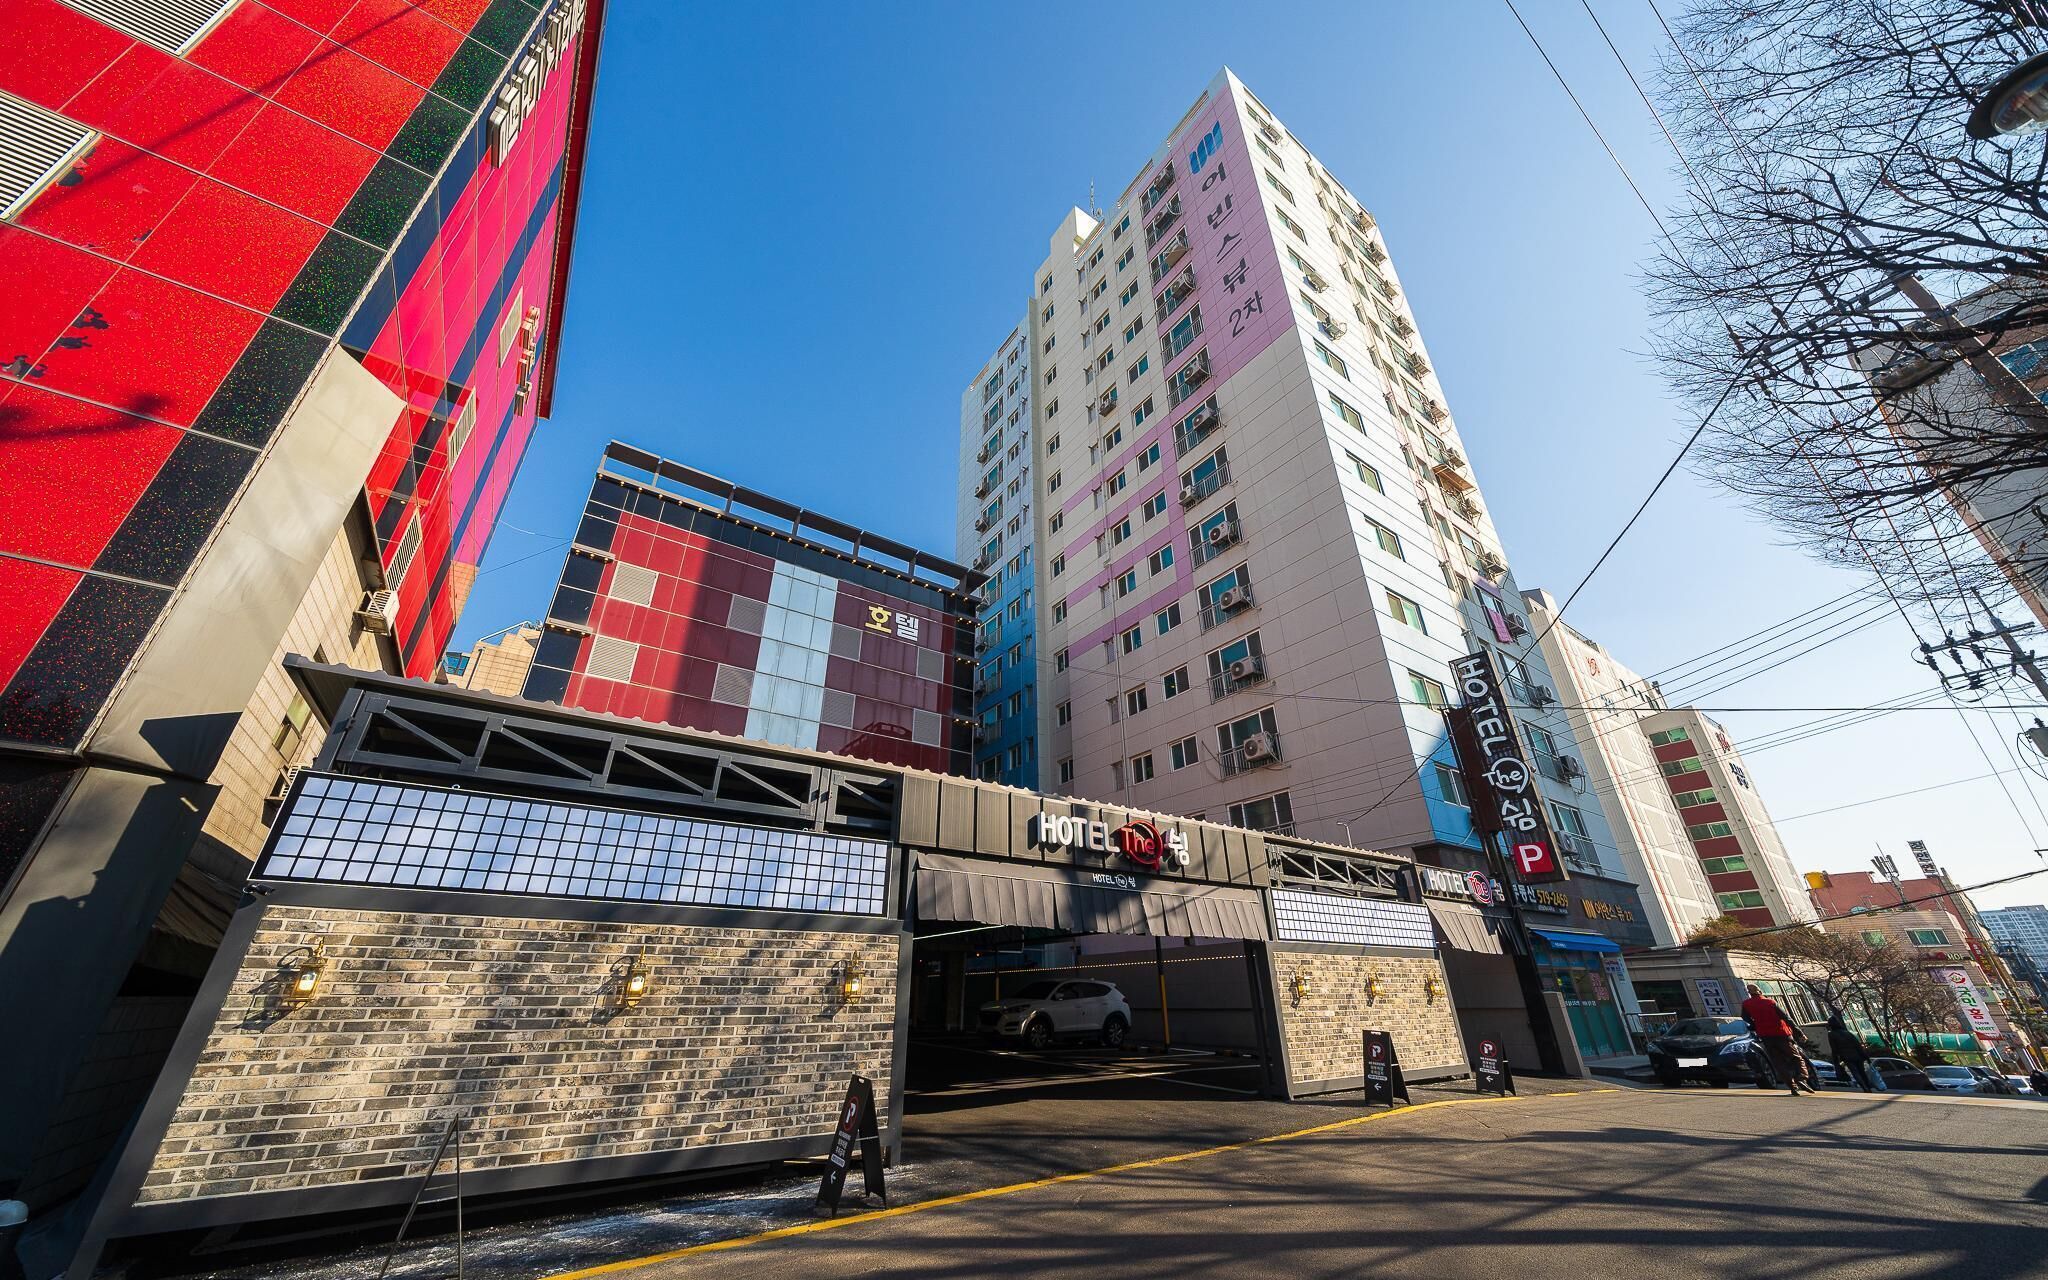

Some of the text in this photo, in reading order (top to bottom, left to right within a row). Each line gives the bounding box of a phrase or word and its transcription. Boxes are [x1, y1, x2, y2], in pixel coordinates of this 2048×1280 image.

[1201, 162, 1263, 338] 어반스뷰 2차
[865, 605, 919, 642] 호텔
[1458, 658, 1537, 831] HOTEL The 쉼
[1036, 811, 1120, 853] HOTEL
[1120, 827, 1156, 855] The
[1518, 844, 1543, 873] P
[1092, 873, 1115, 884] HOTEL
[1424, 868, 1470, 895] HOTEL
